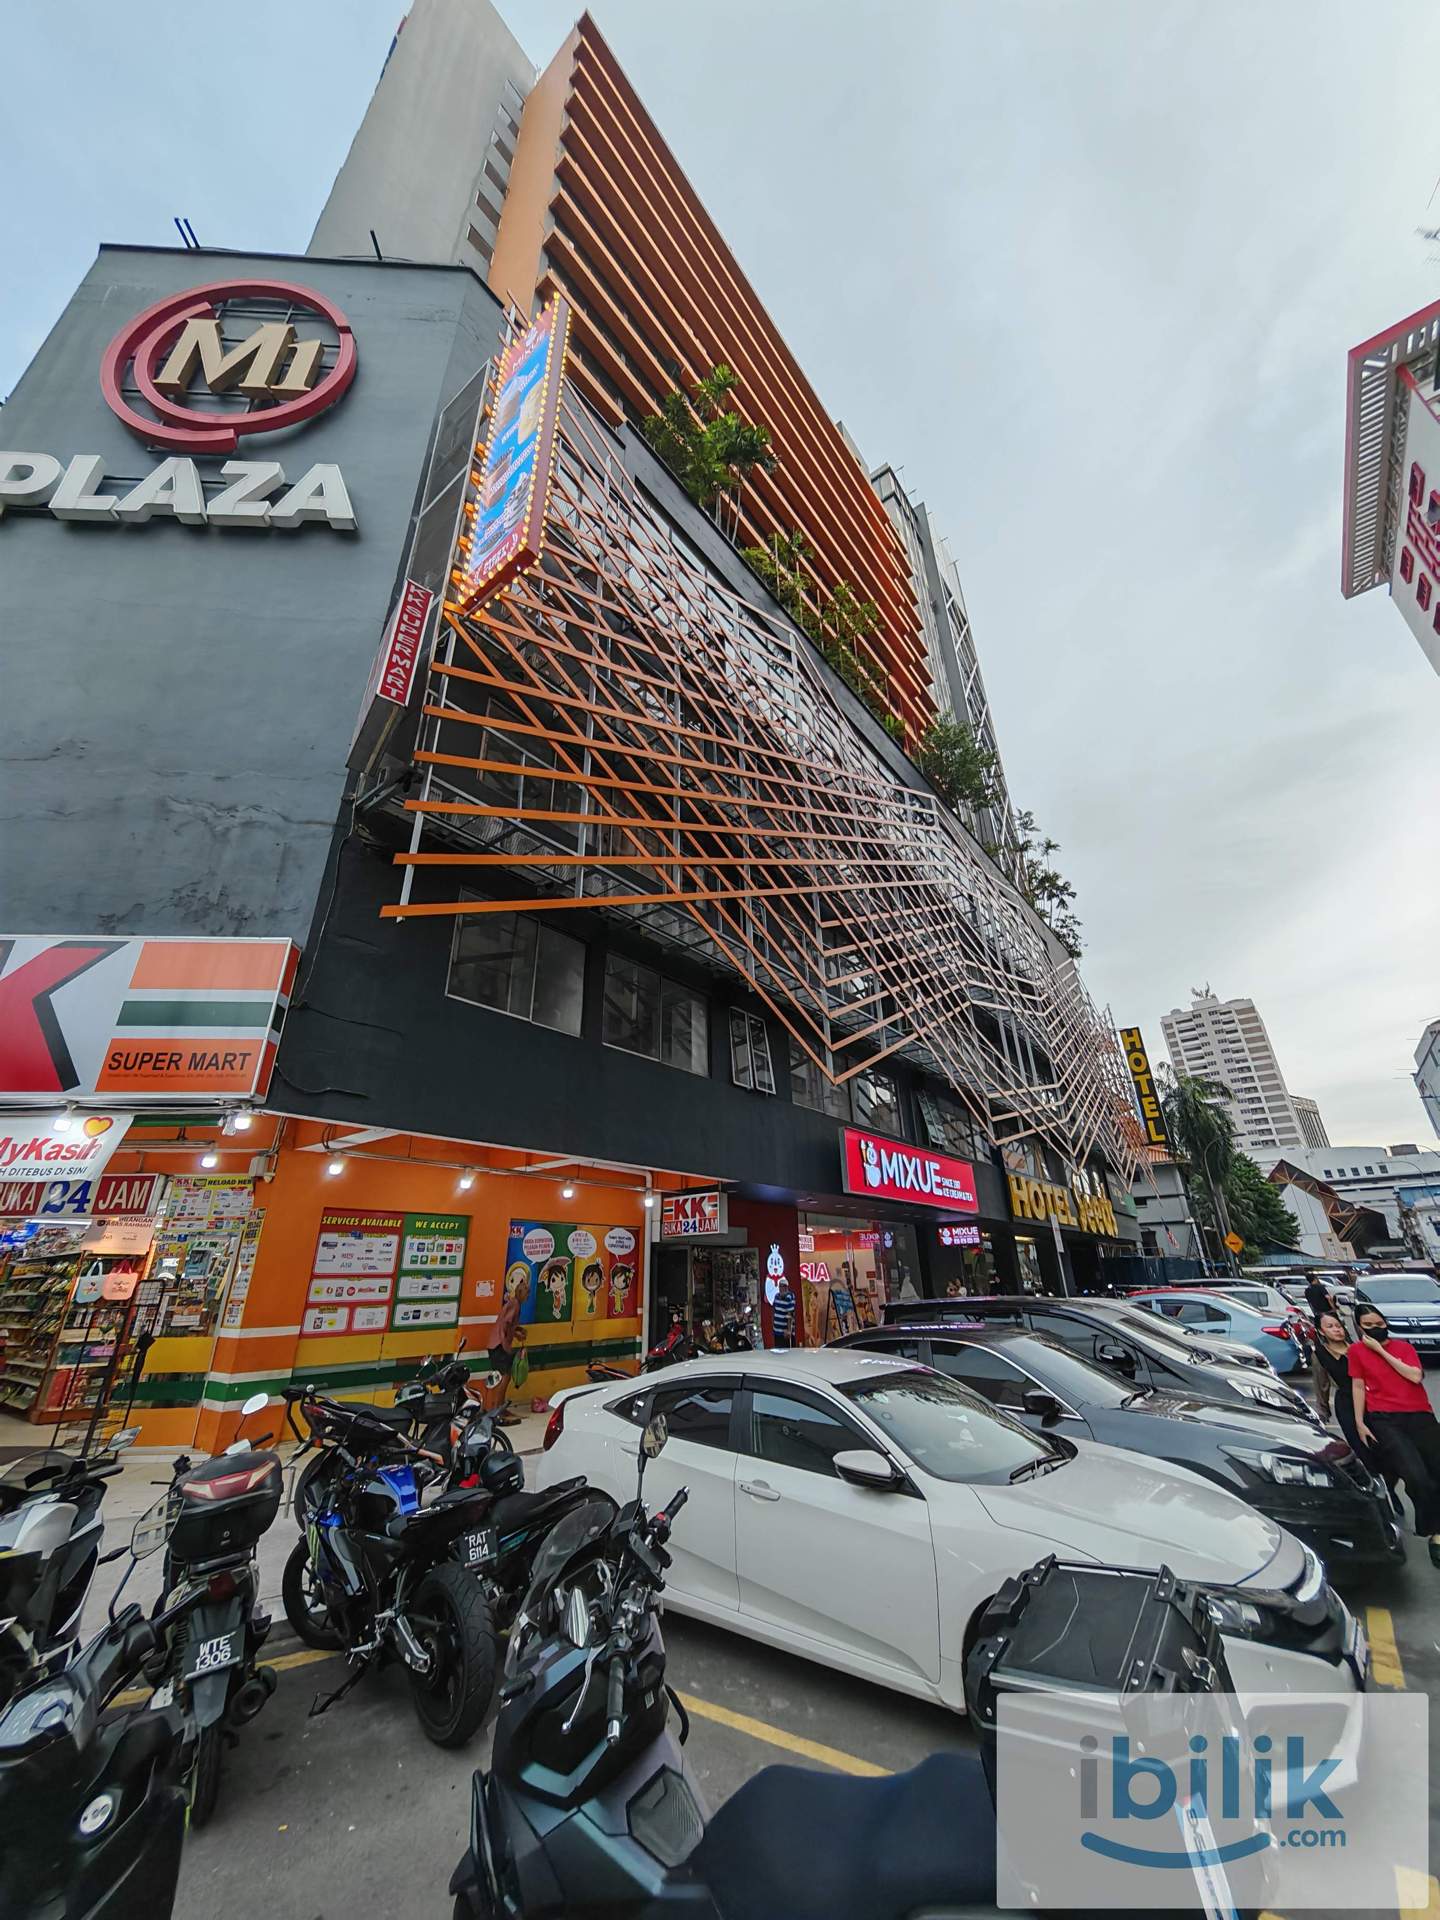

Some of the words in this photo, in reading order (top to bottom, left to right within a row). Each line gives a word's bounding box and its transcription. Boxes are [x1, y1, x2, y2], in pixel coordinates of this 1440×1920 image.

[0, 450, 358, 530] PLAZA
[108, 1052, 183, 1071] SUPER
[188, 1052, 252, 1071] MART
[1121, 1029, 1166, 1142] HOTEL
[8, 1167, 51, 1176] DITEBUS
[54, 1167, 66, 1176] DI
[67, 1166, 88, 1175] SINI
[880, 1148, 943, 1196] MIXUE
[0, 1182, 37, 1211] UKA
[41, 1180, 93, 1213] 24
[98, 1180, 152, 1210] JAM
[1008, 1174, 1079, 1226] HOTEL
[674, 1195, 707, 1220] KK
[322, 1216, 360, 1226] SERVICES
[361, 1218, 402, 1228] AVAILABLE
[415, 1220, 429, 1229] WE
[430, 1221, 460, 1230] ACCEPT
[664, 1221, 682, 1235] BUKA
[683, 1219, 697, 1232] 24
[699, 1218, 718, 1232] JAM
[952, 1226, 979, 1235] MIXUE
[469, 1530, 488, 1548] RAT
[469, 1543, 489, 1561] 6114
[200, 1634, 232, 1657] WTE
[195, 1647, 232, 1671] 1306
